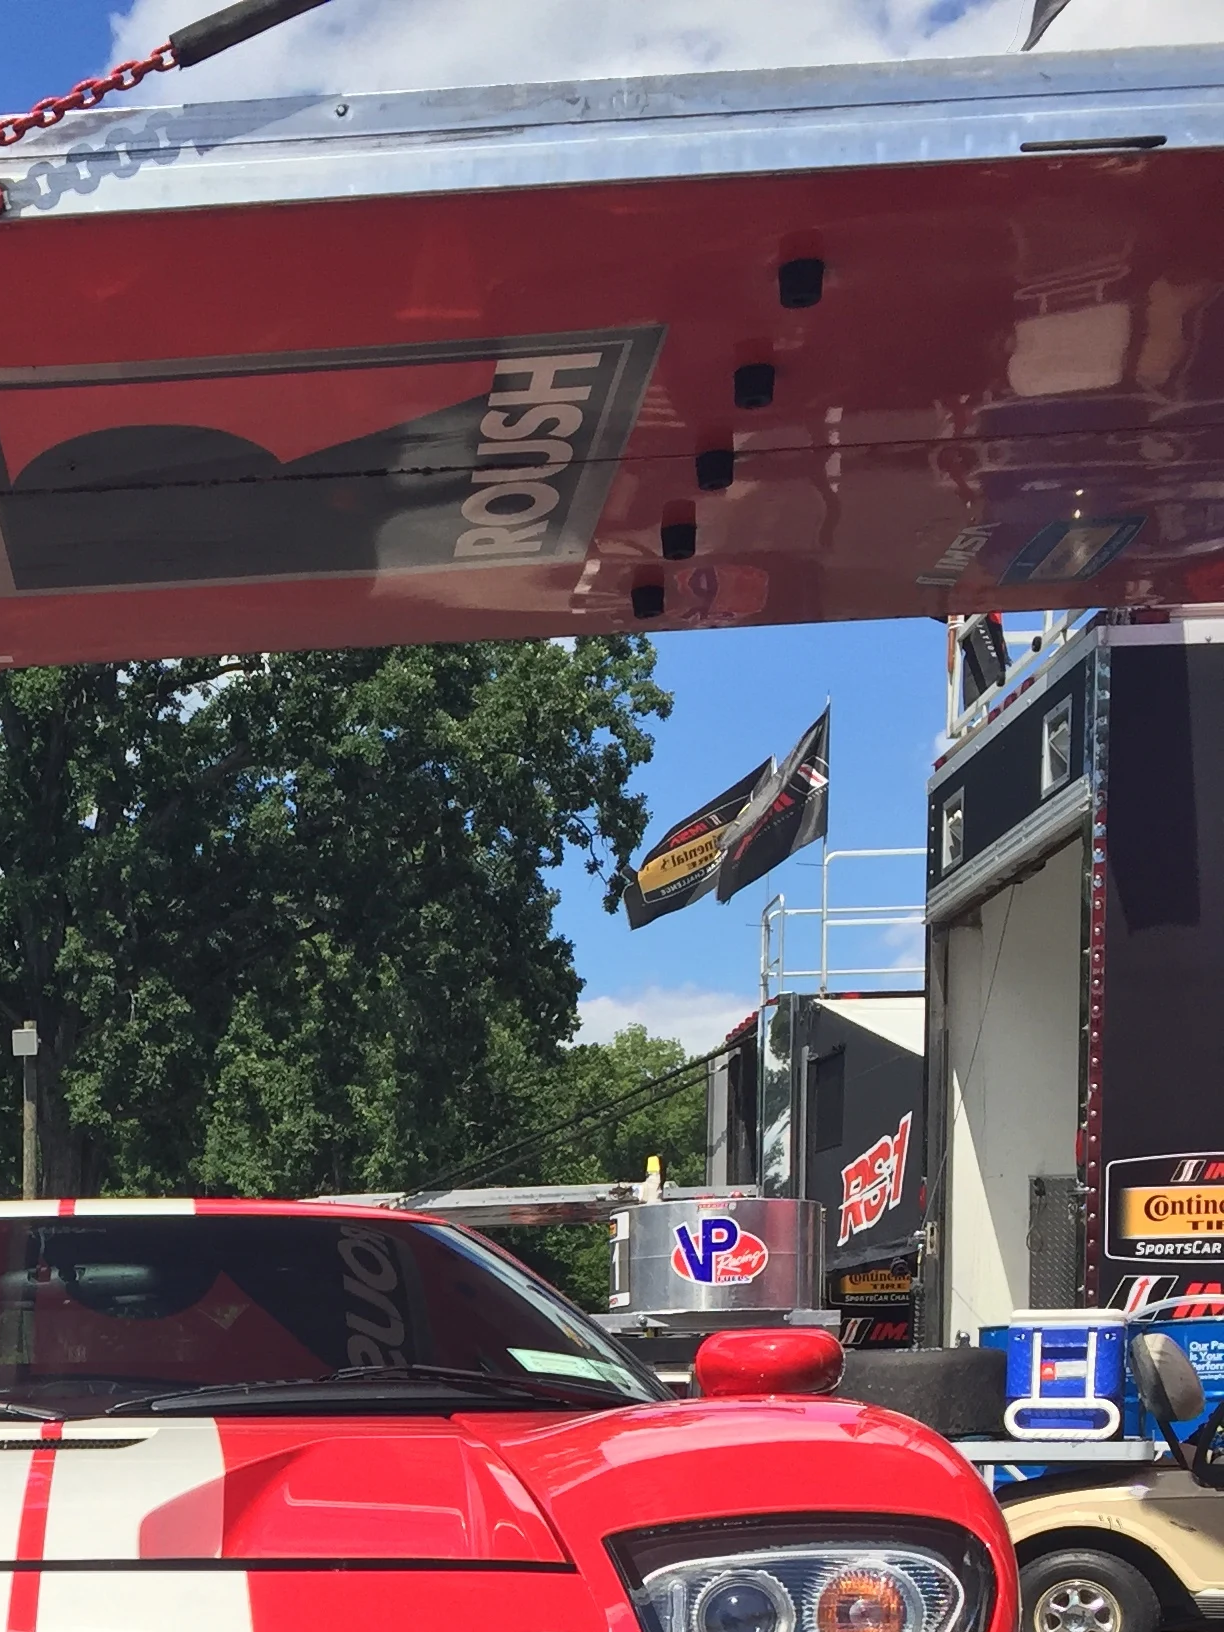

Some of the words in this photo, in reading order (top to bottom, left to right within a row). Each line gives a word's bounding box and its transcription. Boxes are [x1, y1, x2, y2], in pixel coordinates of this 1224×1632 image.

[453, 352, 603, 557] ROUSH
[934, 522, 1002, 572] IMSA
[675, 1218, 739, 1283] VP
[716, 1248, 766, 1276] Racing
